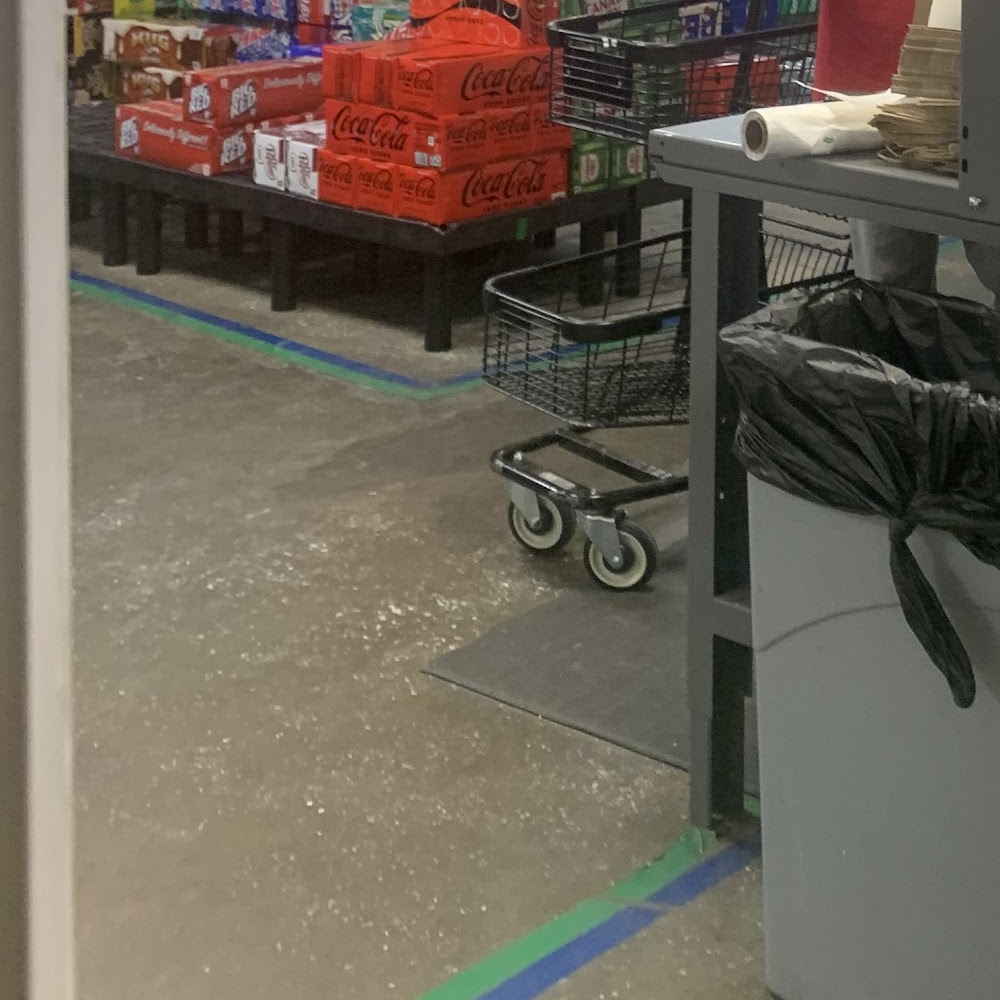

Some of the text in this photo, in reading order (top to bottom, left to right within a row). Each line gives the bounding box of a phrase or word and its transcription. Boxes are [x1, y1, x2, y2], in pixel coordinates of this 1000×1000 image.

[191, 82, 209, 97] BIG
[231, 79, 254, 101] BIG
[189, 95, 211, 114] RED
[230, 95, 257, 120] RED
